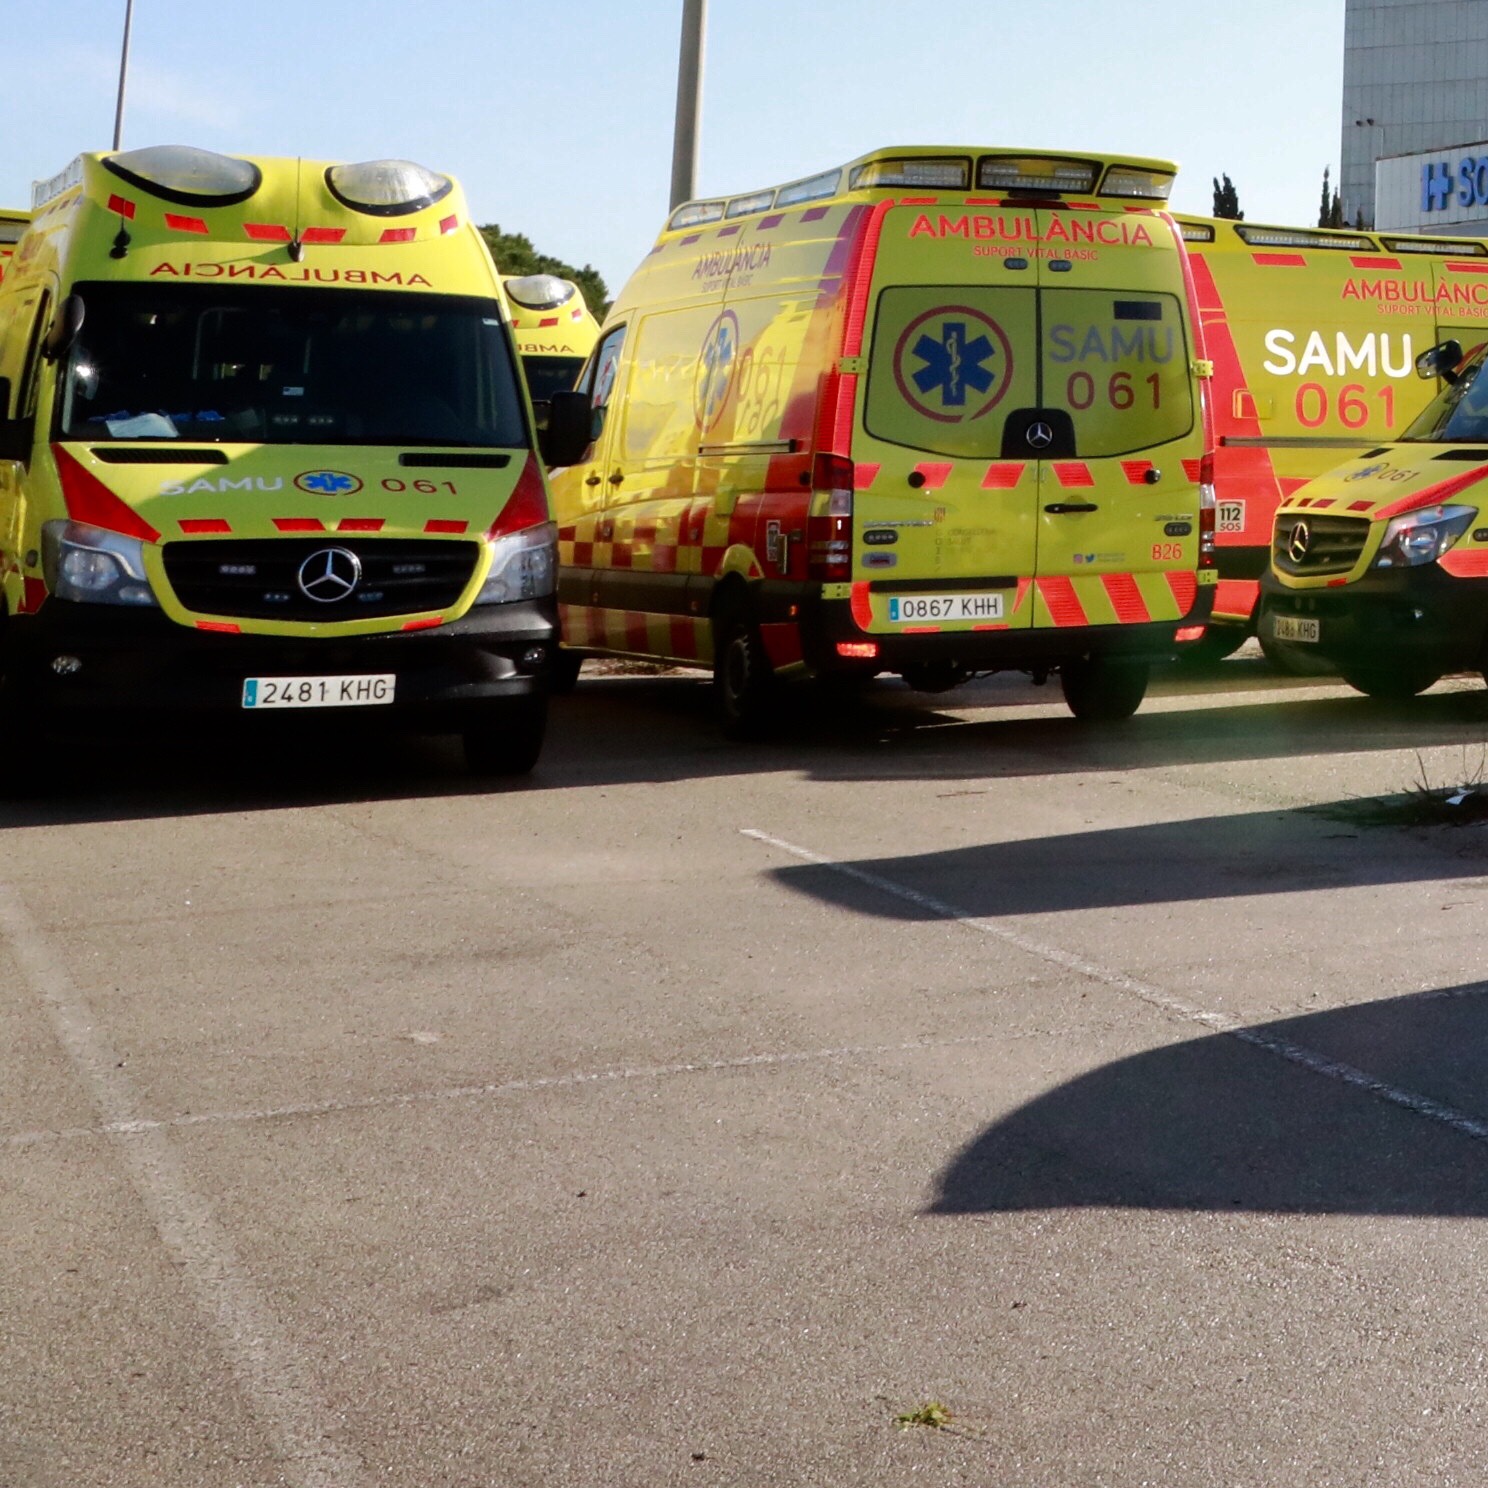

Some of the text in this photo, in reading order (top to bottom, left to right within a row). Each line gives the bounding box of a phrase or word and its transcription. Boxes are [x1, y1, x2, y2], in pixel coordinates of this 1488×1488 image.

[908, 212, 1153, 247] AMBULÀNCIA
[974, 245, 1023, 257] SUPORT
[1027, 248, 1060, 259] VITAL
[1377, 303, 1421, 315] SUPORT
[1425, 306, 1456, 316] VITAL
[1050, 323, 1174, 364] SAMU
[1263, 328, 1413, 377] SAMU
[1067, 371, 1160, 410] 061
[1295, 382, 1395, 430] 061
[160, 476, 457, 496] SAMU 061
[1219, 507, 1241, 521] 112
[1219, 522, 1241, 532] SOS
[1152, 543, 1183, 561] B26
[903, 597, 998, 618] 0867 KHH
[1298, 622, 1316, 639] KHG
[262, 679, 387, 704] 2481 KHG
